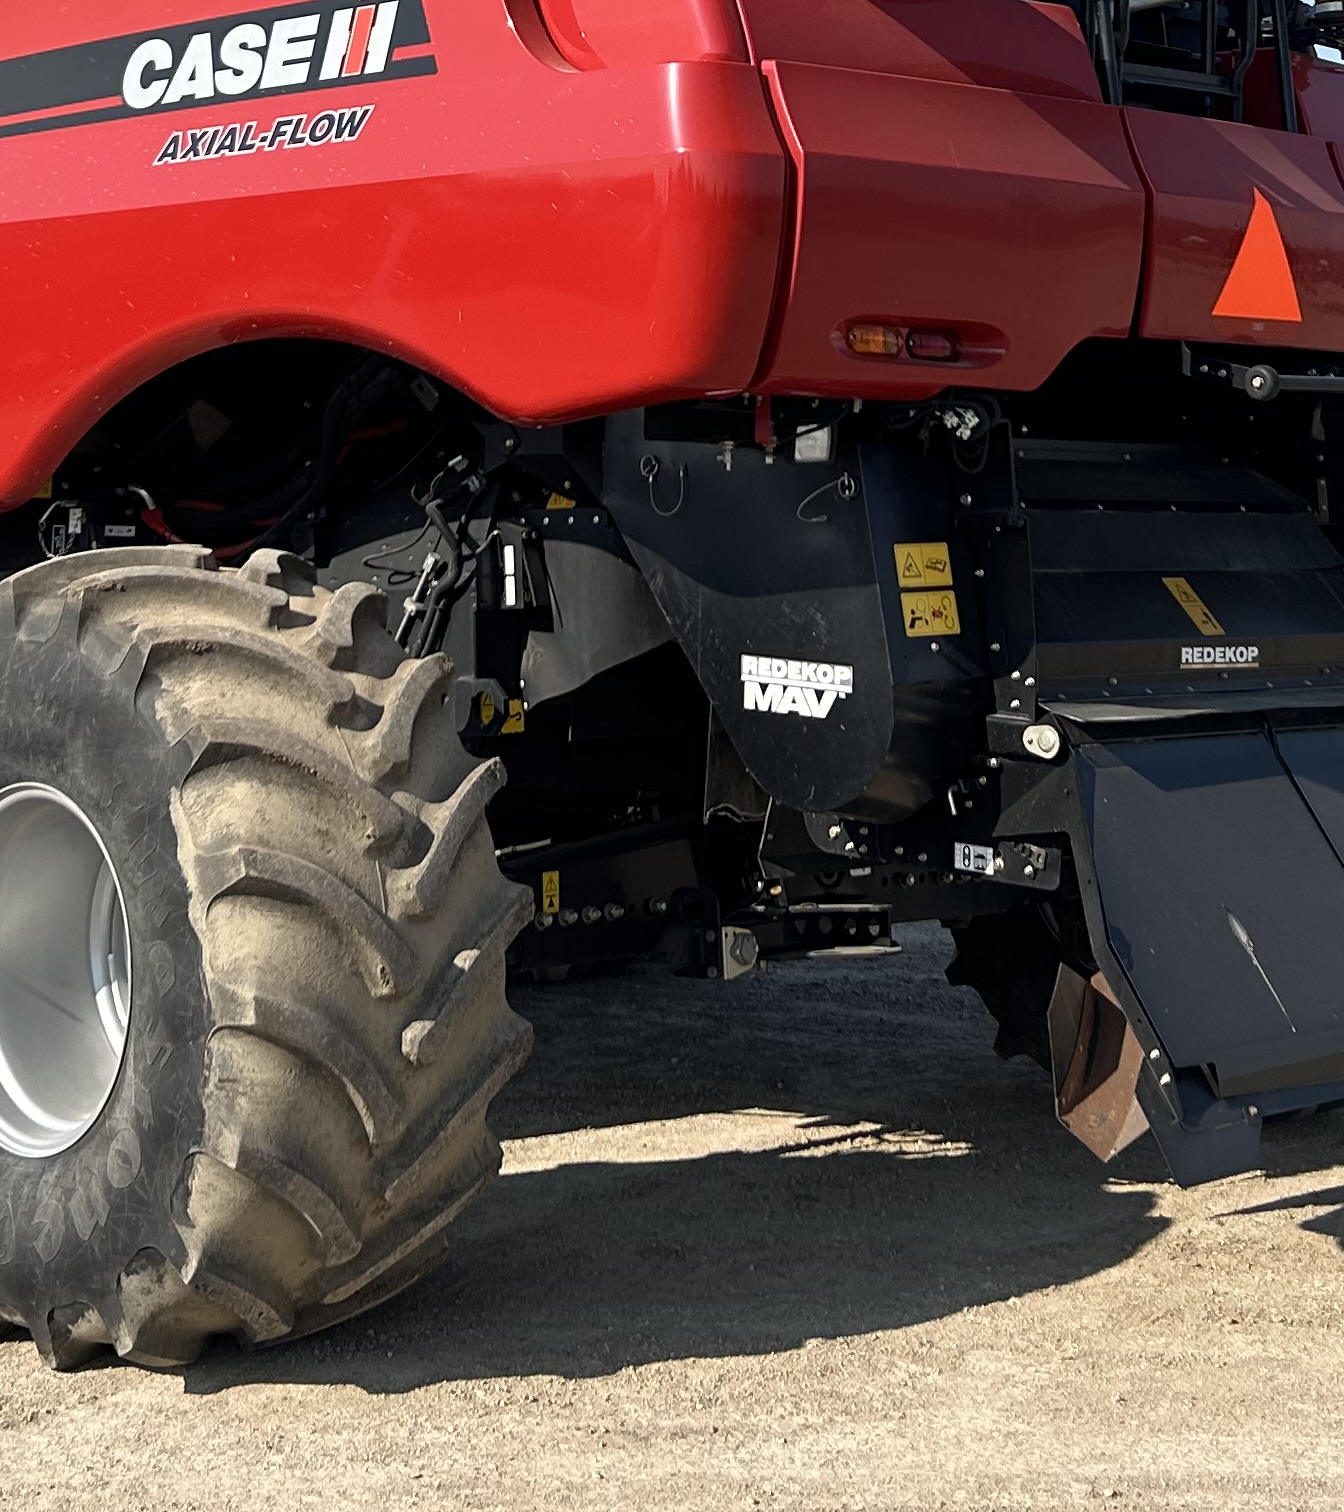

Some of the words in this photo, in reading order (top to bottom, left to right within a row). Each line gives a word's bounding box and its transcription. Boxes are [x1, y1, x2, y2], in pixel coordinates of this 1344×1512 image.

[122, 14, 321, 109] CASE
[154, 106, 374, 165] AXIAL-FLOW
[741, 655, 851, 685] REDEKOP
[1181, 646, 1259, 663] REDEKOP
[744, 681, 839, 719] MAV
